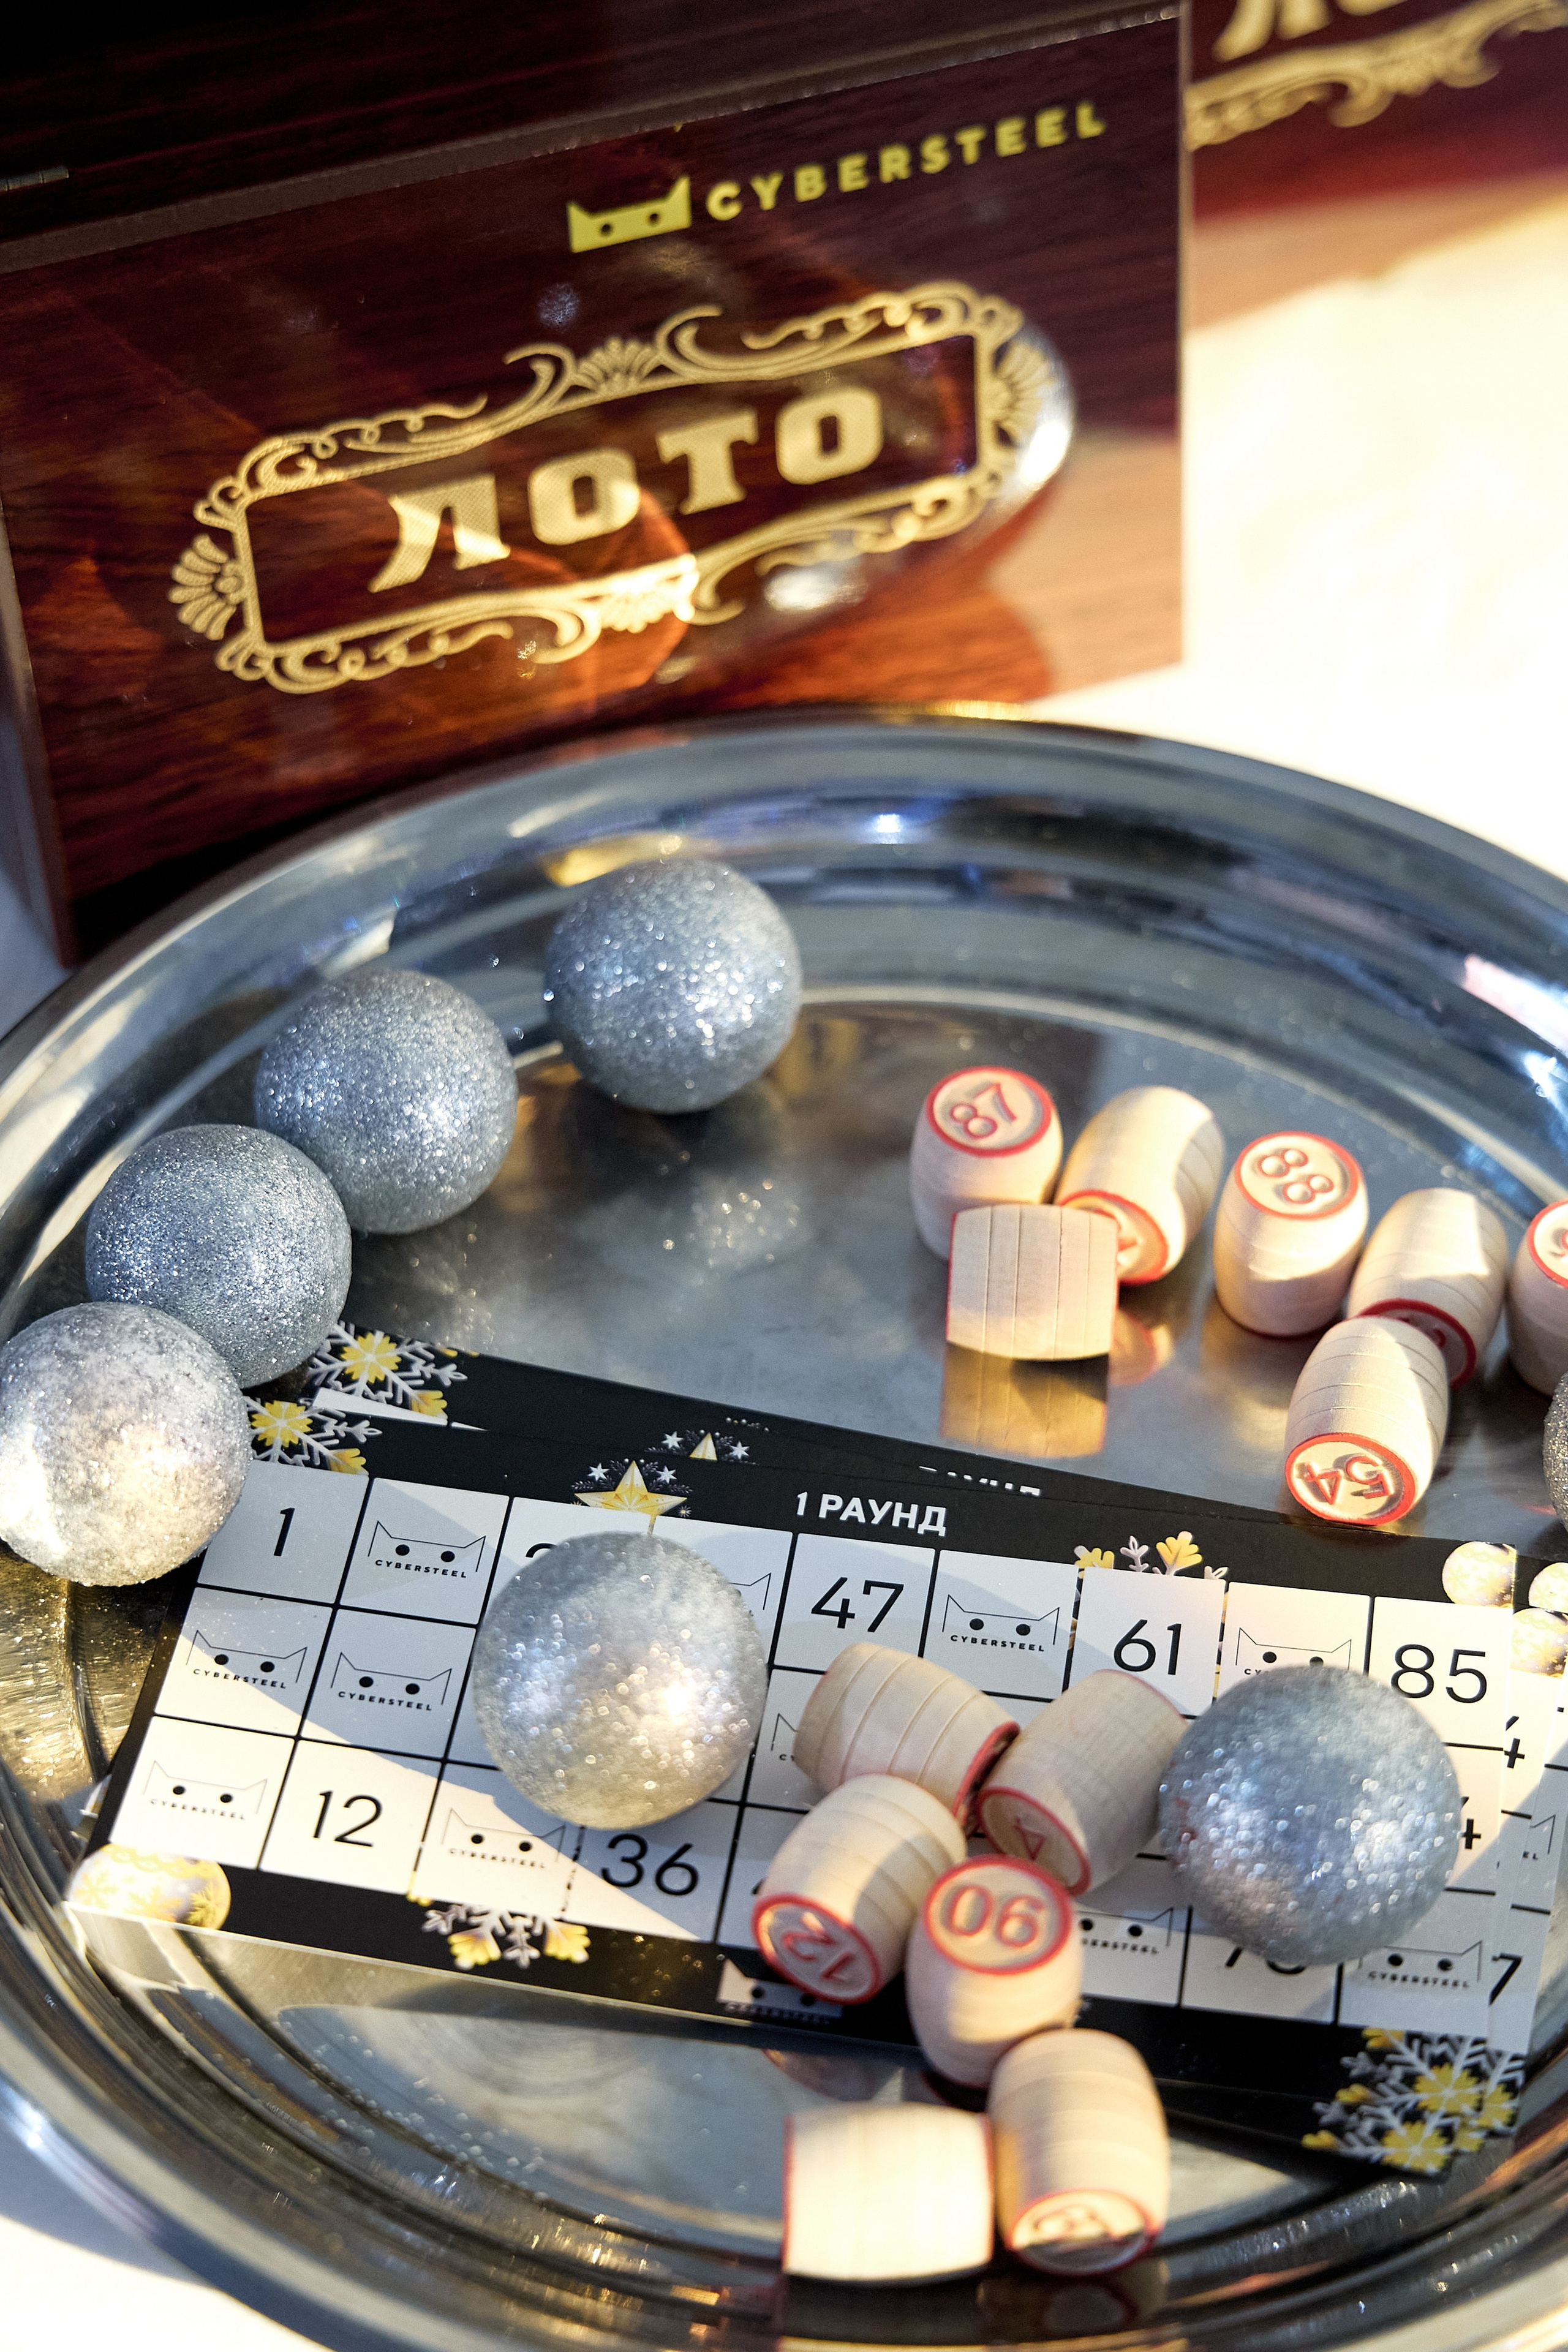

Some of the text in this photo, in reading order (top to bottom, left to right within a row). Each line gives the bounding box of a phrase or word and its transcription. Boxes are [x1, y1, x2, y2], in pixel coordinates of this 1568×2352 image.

[706, 100, 1106, 221] CYBERSTEEL
[369, 387, 883, 593] ЛОТО
[950, 1081, 1017, 1139] 87
[1256, 1148, 1334, 1204] 88
[1305, 1455, 1392, 1505] 54
[273, 1507, 296, 1556] 1
[796, 1491, 947, 1537] 1 РАУНД
[375, 1559, 467, 1578] CYBERSTEEL
[811, 1577, 905, 1633] 47
[951, 1635, 1044, 1653] CYBERSTEEL
[1114, 1619, 1182, 1676] 61
[193, 1668, 287, 1689] CYBERSTEEL
[1391, 1644, 1487, 1703] 85
[338, 1691, 432, 1711] CYBERSTEEL
[150, 1798, 245, 1820] CYBERSTEEL
[313, 1790, 383, 1847] 12
[450, 1848, 545, 1869] CYBERSTEEL
[601, 1833, 699, 1896] 36
